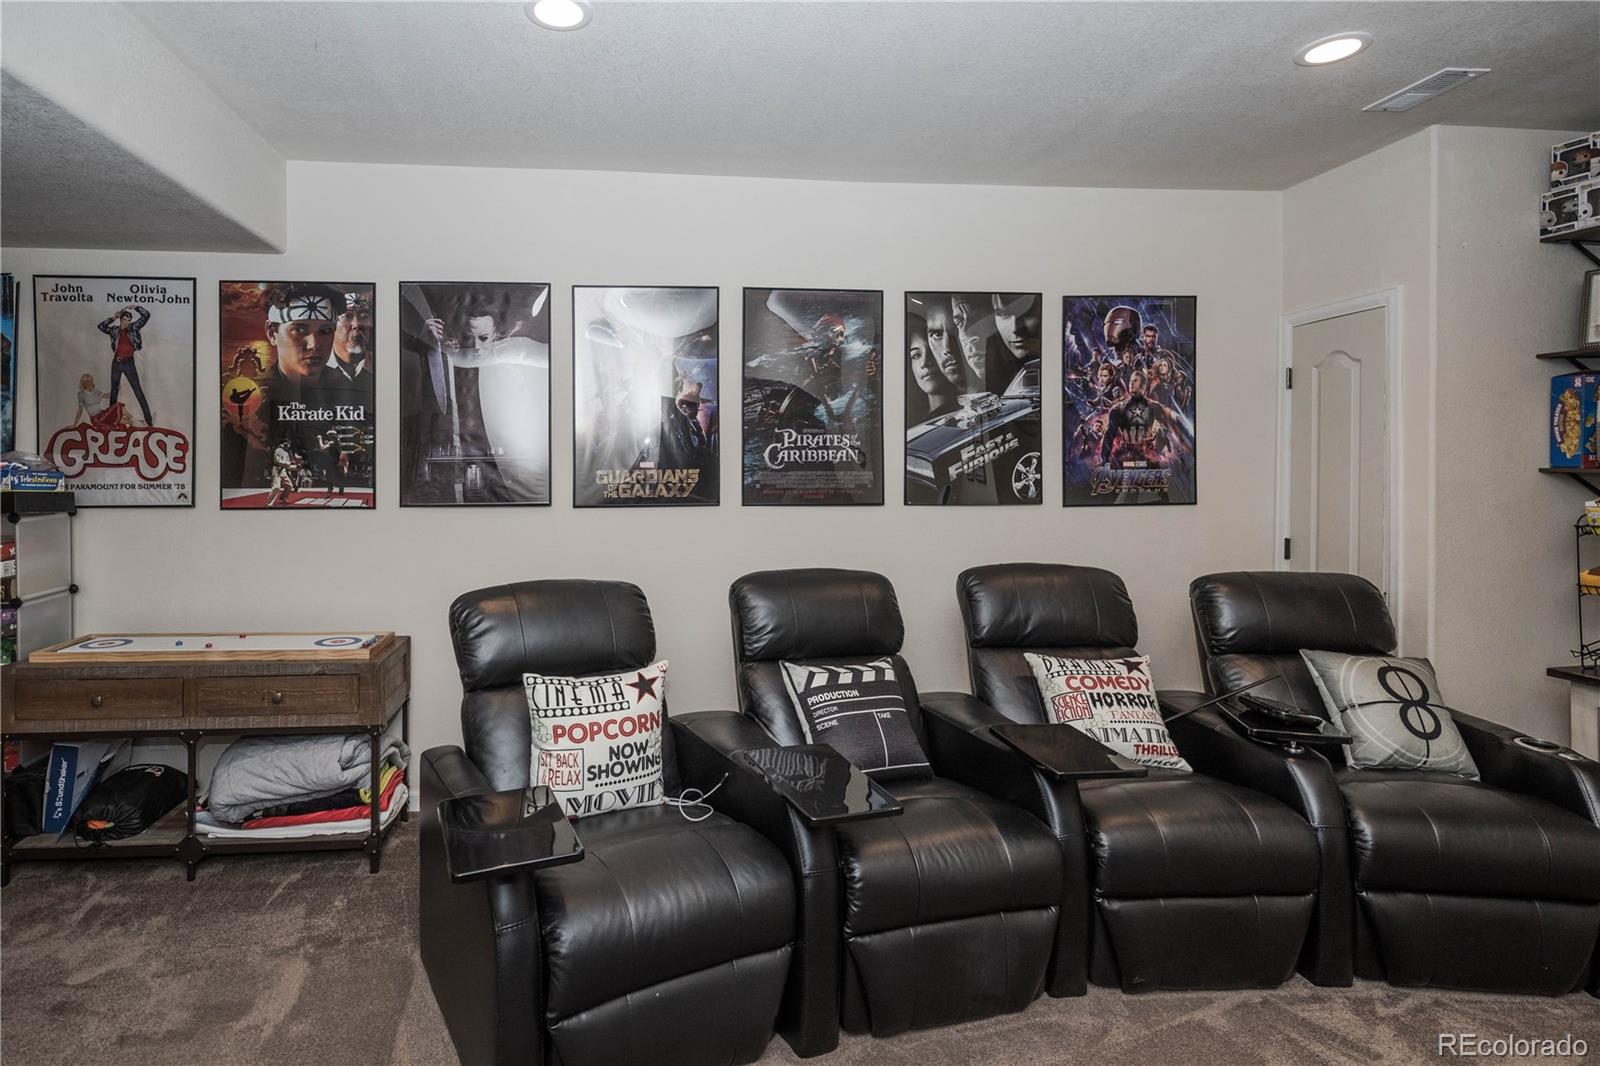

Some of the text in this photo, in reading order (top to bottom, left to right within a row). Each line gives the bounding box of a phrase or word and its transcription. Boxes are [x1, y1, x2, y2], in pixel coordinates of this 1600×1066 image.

[52, 283, 83, 293] John
[130, 284, 167, 294] Olivia
[41, 292, 93, 302] Travolta
[107, 293, 190, 304] Newton-John
[277, 405, 366, 421] Karate Kid
[290, 402, 306, 410] The
[775, 428, 851, 449] PIRATES
[52, 429, 185, 479] GREASE
[763, 443, 860, 470] CARIBBEAN
[960, 434, 1004, 462] FAST
[948, 438, 1019, 482] FURIOUS
[596, 469, 700, 484] GUARDIANS
[1091, 463, 1172, 496] AVENGERS
[618, 483, 696, 498] GALAXY
[1042, 657, 1116, 673] DRAMA
[1065, 675, 1150, 692] COMEDY
[532, 680, 625, 709] CINEMA
[807, 689, 860, 705] PRODUCTION
[1054, 693, 1088, 710] SCIENCE
[1377, 665, 1442, 741] 8
[812, 706, 839, 718] DIRECTOR
[1058, 704, 1091, 721] FICTION
[552, 710, 660, 745] POPCORN
[816, 720, 839, 732] SCENE
[608, 738, 649, 761] NOW
[540, 751, 580, 769] SIT BACK
[548, 768, 581, 788] RELAX
